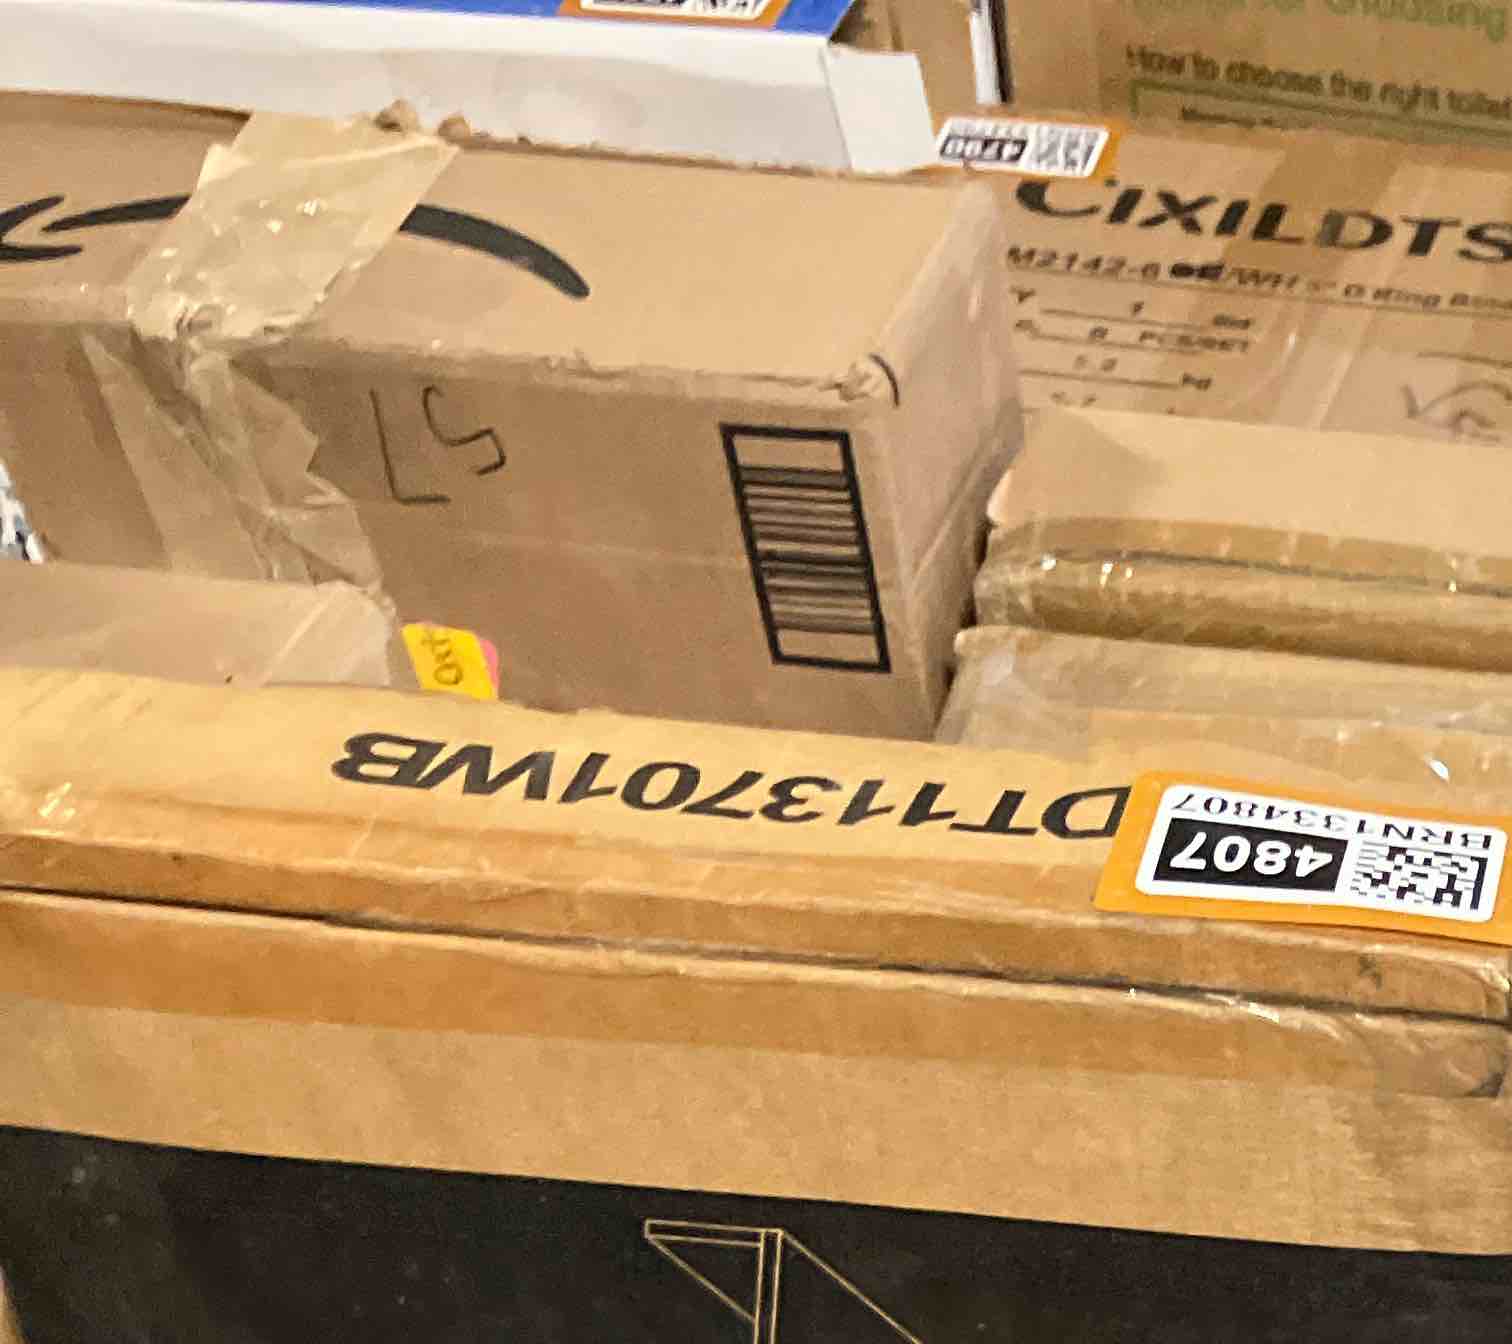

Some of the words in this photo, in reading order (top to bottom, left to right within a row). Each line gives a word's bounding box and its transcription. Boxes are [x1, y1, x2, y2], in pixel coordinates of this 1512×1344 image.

[1329, 70, 1374, 103] the
[330, 730, 1133, 840] DT113701WB
[1171, 792, 1495, 851] BRN1334807
[1169, 830, 1335, 879] 4807
